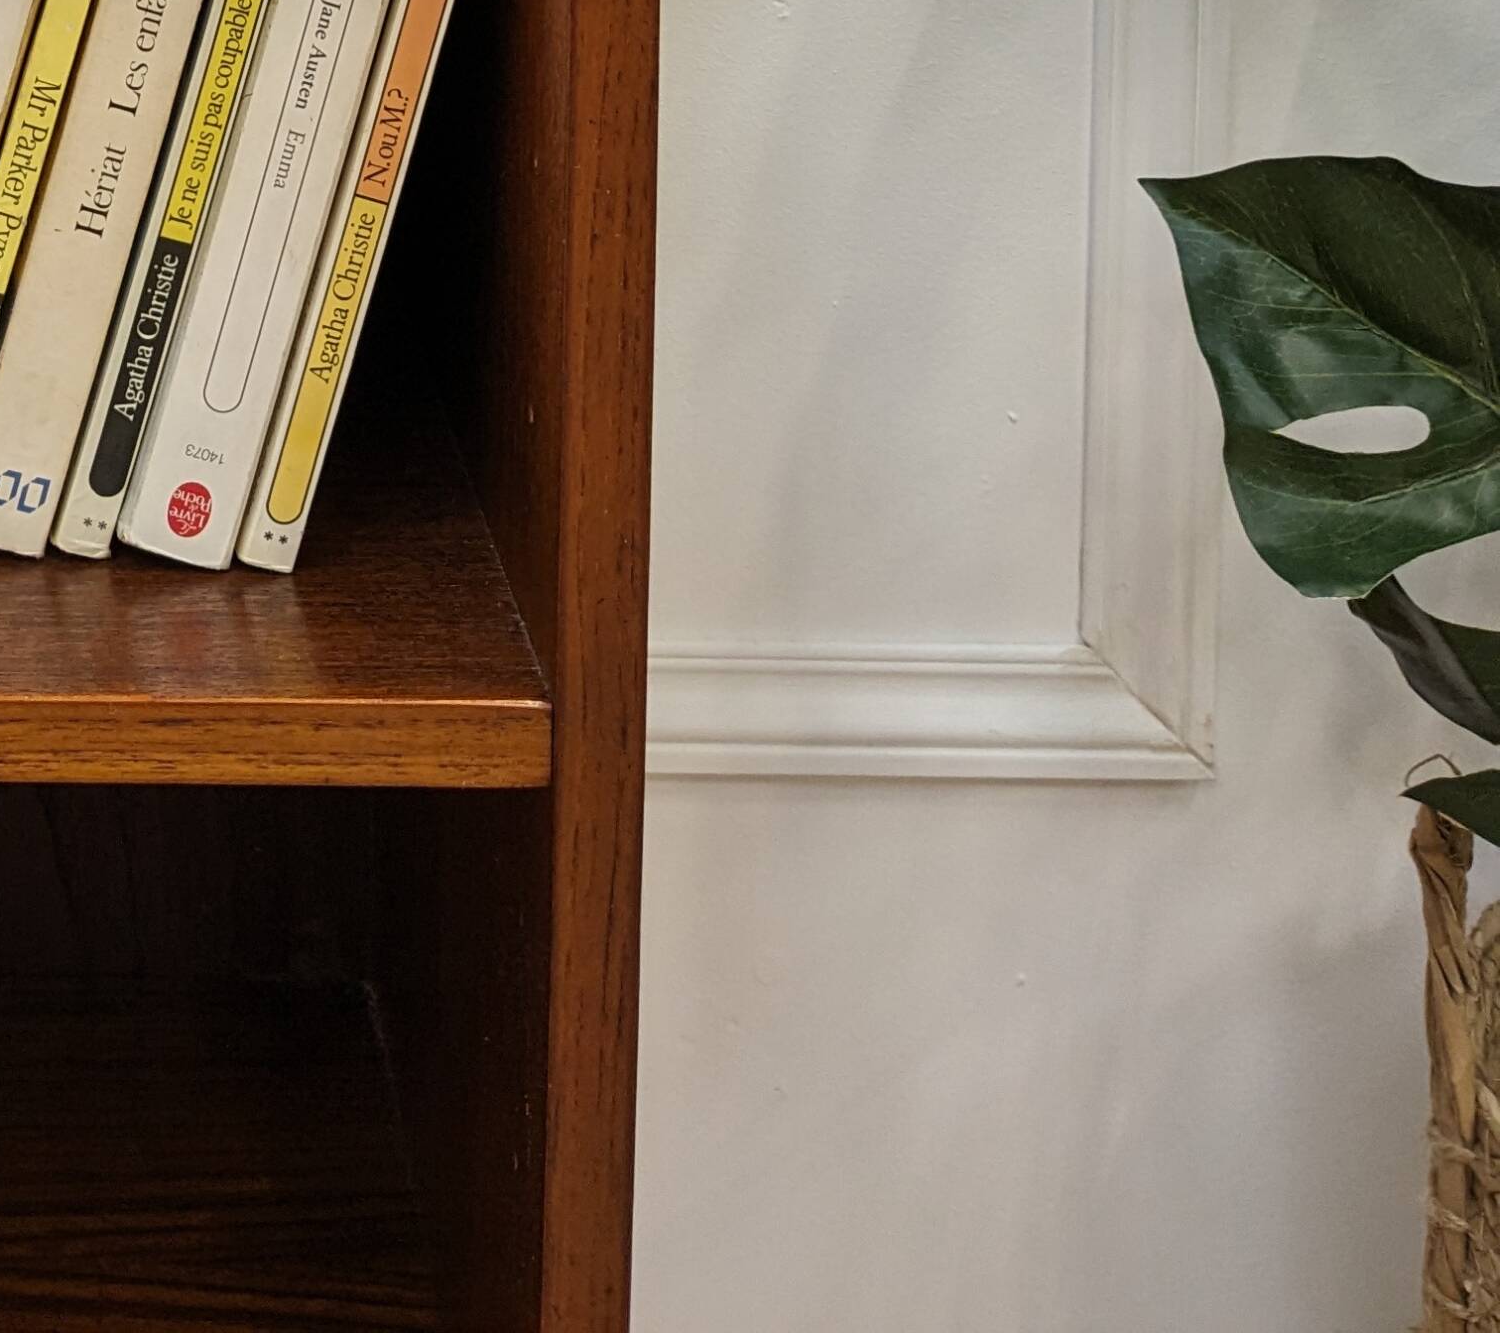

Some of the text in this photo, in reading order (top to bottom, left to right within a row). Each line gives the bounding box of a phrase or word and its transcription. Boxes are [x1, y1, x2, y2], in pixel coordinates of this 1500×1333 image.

[27, 76, 62, 114] Mr
[295, 46, 327, 110] Austen
[204, 89, 224, 132] pas
[3, 121, 49, 206] Parker
[75, 142, 127, 239] Hériat
[108, 60, 149, 117] Les
[190, 130, 215, 173] suis
[273, 128, 305, 189] Emma
[181, 177, 201, 205] ne
[168, 207, 193, 231] Je
[310, 212, 375, 384] Agatha Christie
[114, 254, 179, 422] Agatha Christie
[185, 444, 225, 466] 14073
[170, 506, 205, 528] Livre
[173, 489, 211, 513] Poche
